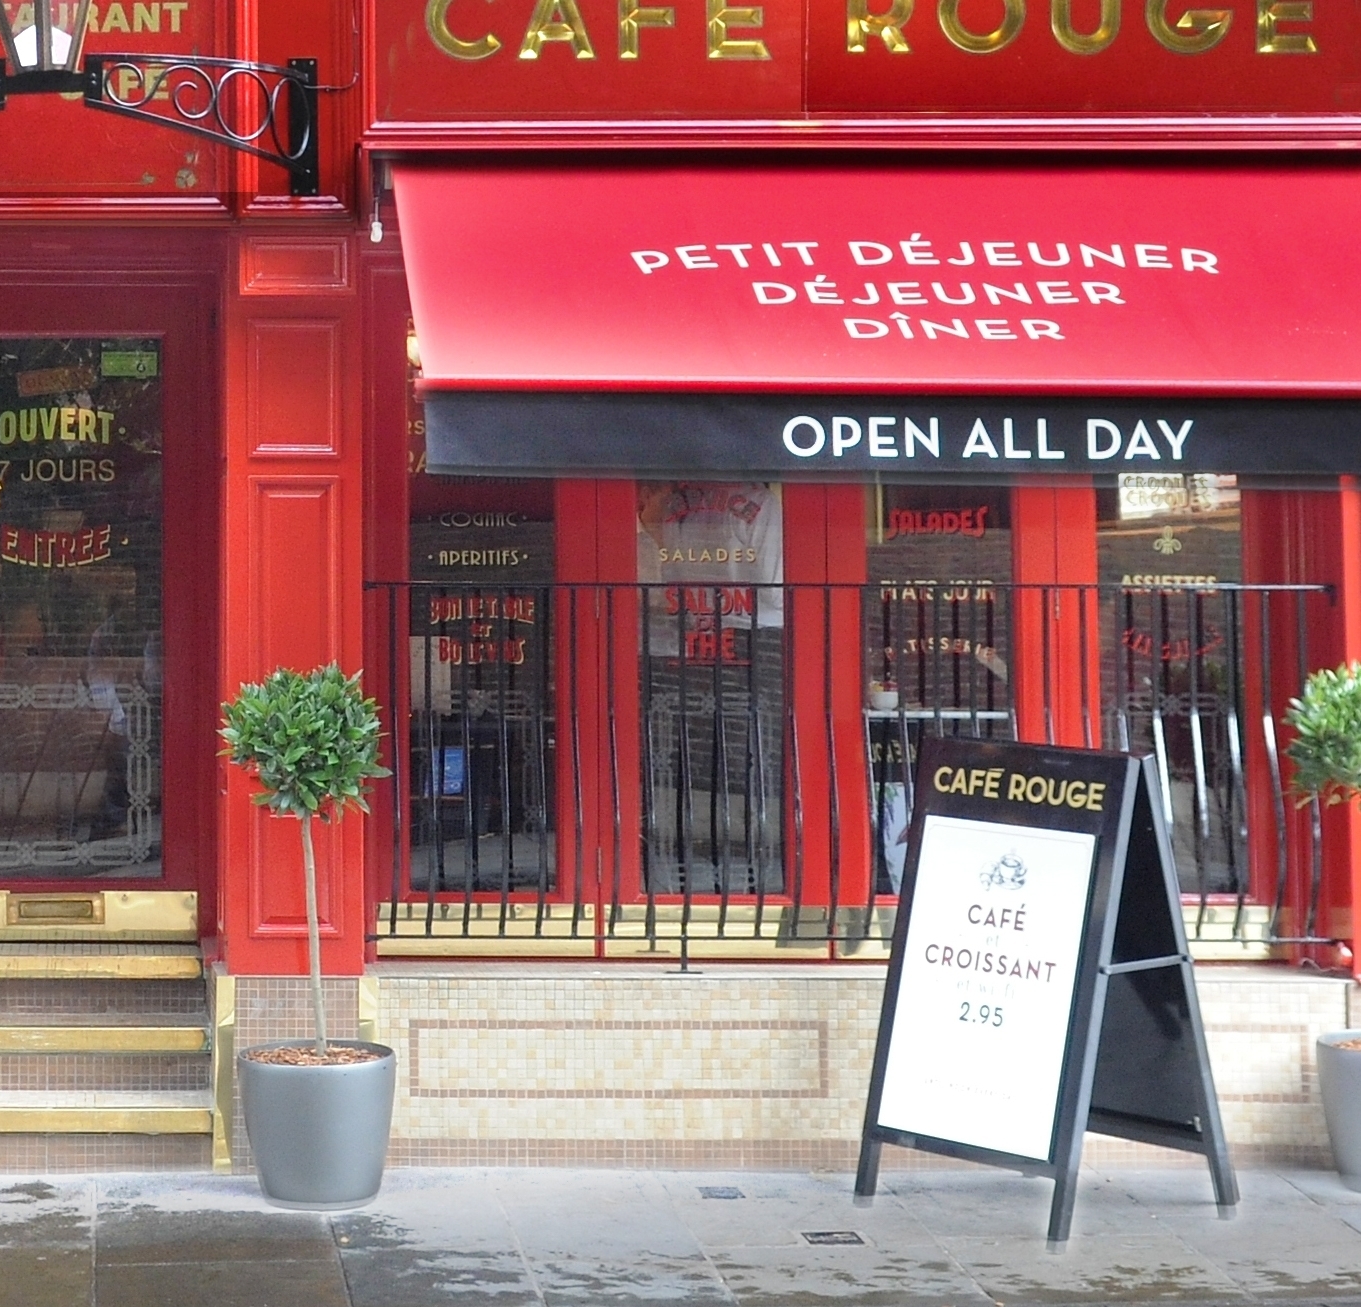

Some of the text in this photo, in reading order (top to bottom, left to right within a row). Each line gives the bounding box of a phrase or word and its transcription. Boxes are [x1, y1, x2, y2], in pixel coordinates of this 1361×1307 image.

[847, 0, 1319, 56] ROUGE
[631, 232, 1221, 276] PETIT DÉJEUNER
[753, 273, 1127, 308] DÉJEUNER
[843, 312, 1067, 341] DÎNER
[782, 415, 1193, 462] OPEN ALL DAY
[21, 459, 115, 482] JOURS
[440, 511, 518, 527] COGNAC
[886, 505, 988, 540] SALADES
[439, 550, 519, 566] APERITIFS
[659, 548, 757, 563] SALADES
[1121, 574, 1217, 593] ASSIETTES
[665, 586, 753, 616] SALON
[884, 636, 997, 661] PTISSERIE
[934, 766, 1107, 811] CAFÉ ROUGE
[968, 903, 1027, 931] CAFÉ
[925, 944, 1057, 984] CROISSANT
[959, 1001, 1004, 1027] 2.95
